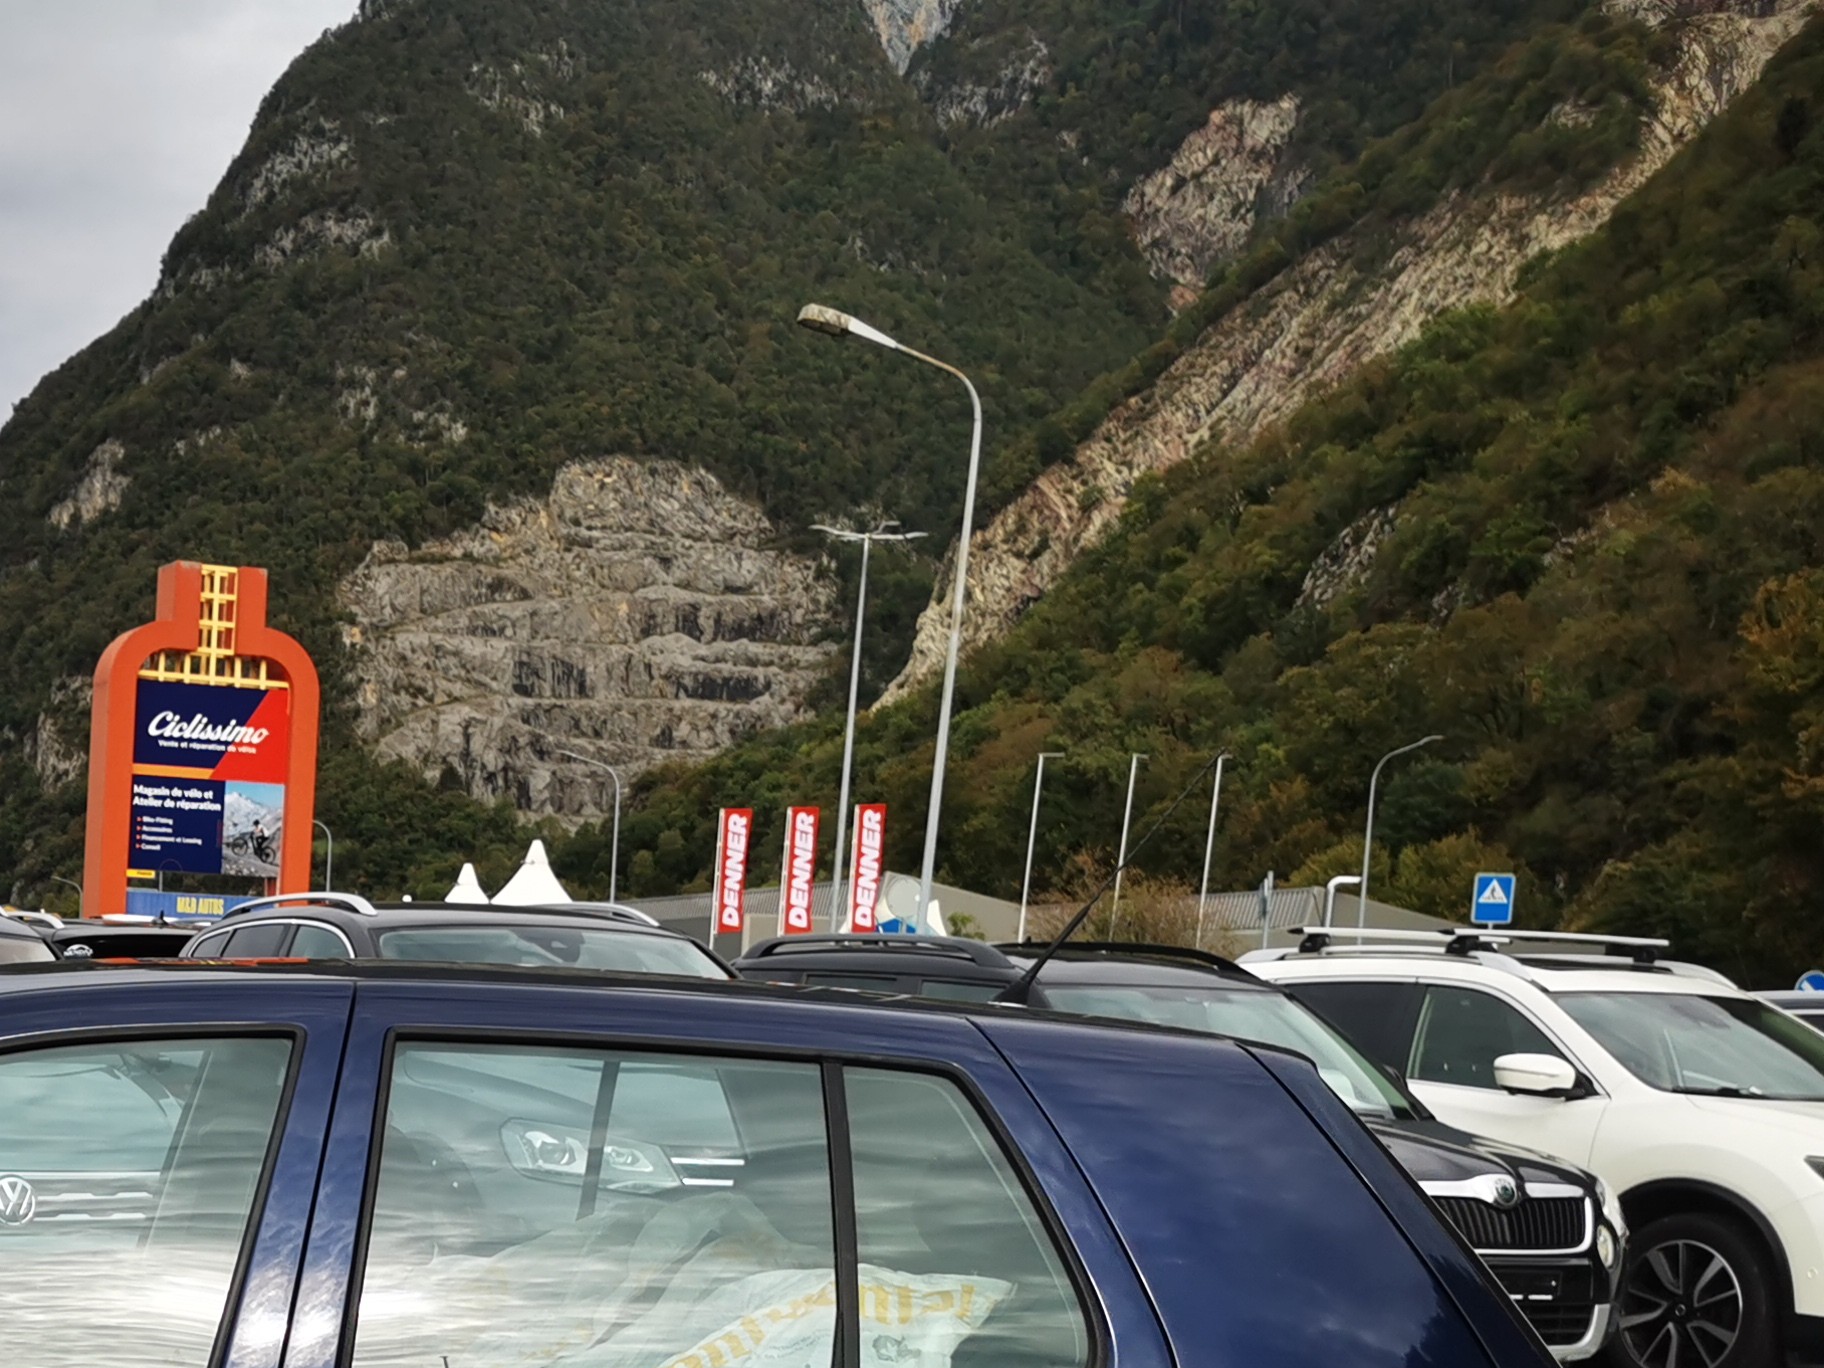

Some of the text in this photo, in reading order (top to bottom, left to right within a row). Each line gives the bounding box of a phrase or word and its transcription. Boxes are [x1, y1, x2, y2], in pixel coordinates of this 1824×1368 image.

[148, 710, 269, 744] Ciclissimo
[133, 796, 222, 811] Atelier de réparation
[134, 784, 213, 799] Magasin de vélo et
[722, 813, 747, 927] DENNER
[788, 811, 815, 928] DENNER
[855, 808, 881, 927] DENNER
